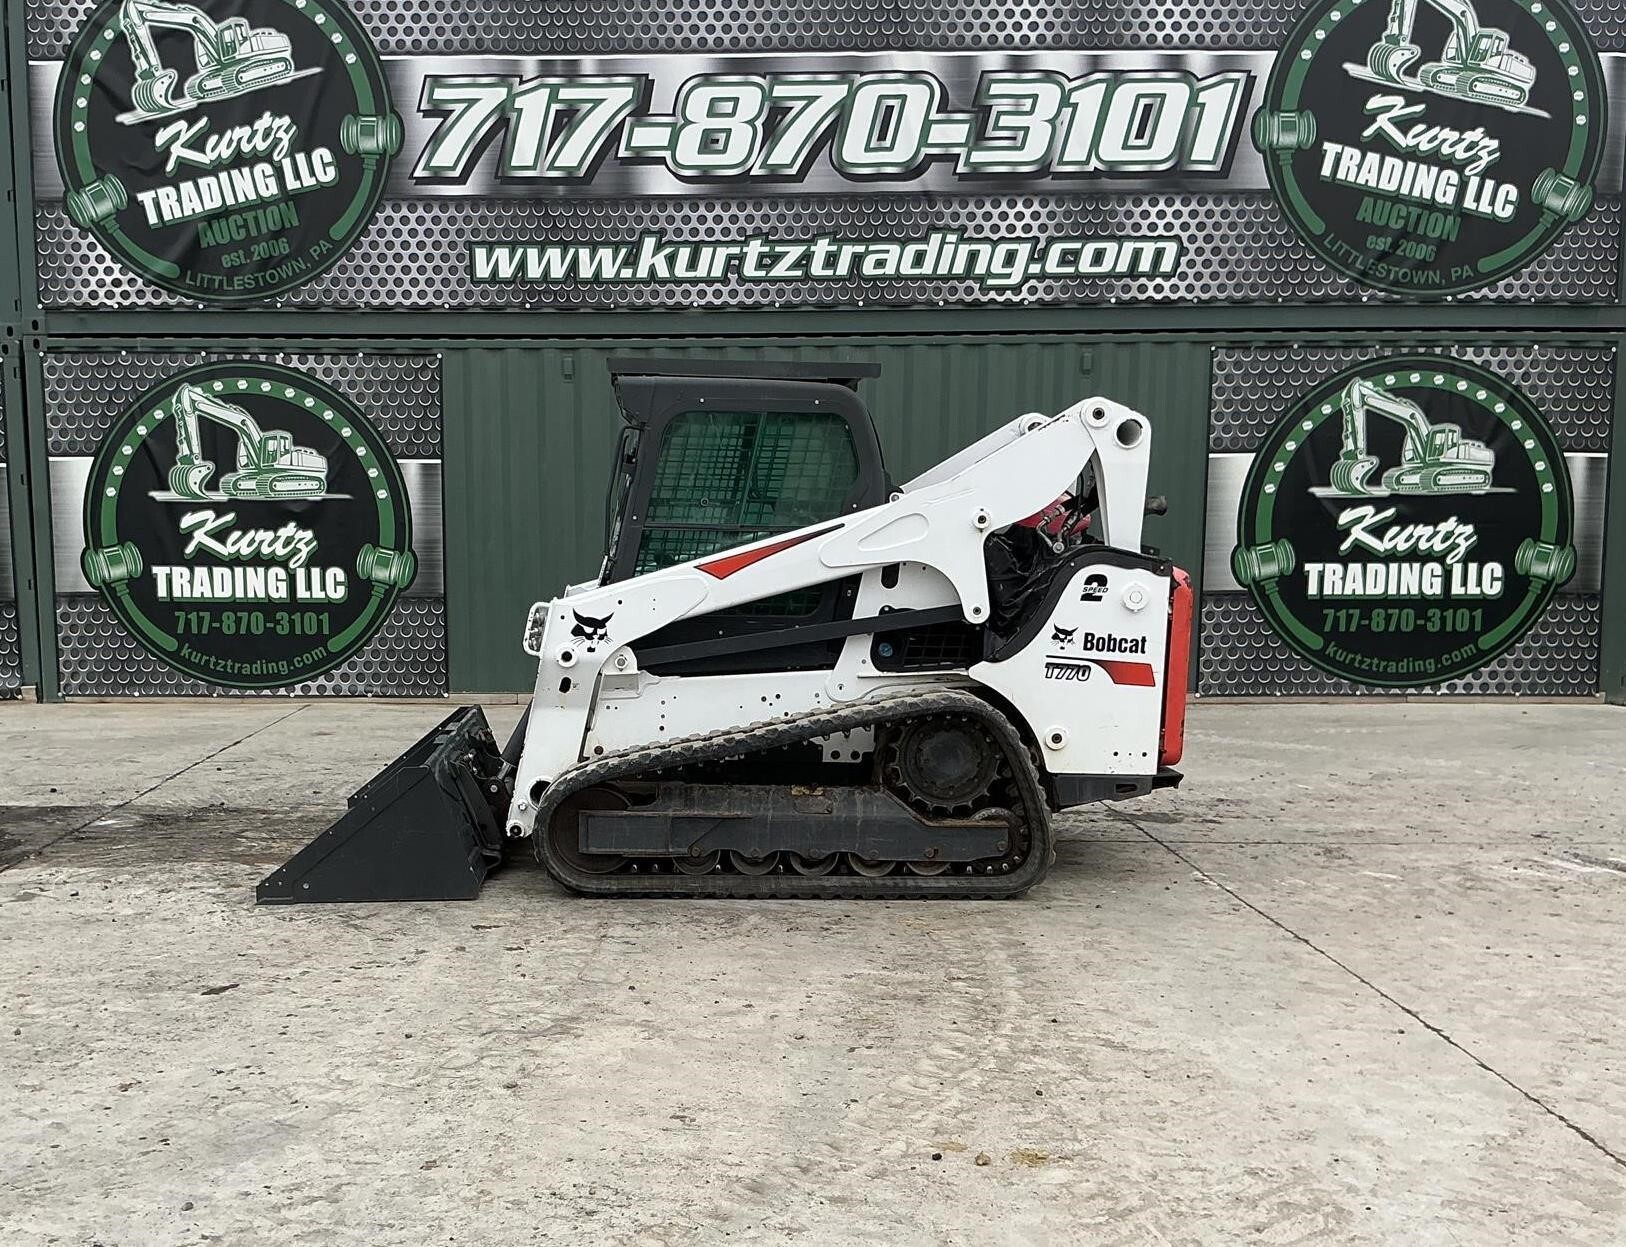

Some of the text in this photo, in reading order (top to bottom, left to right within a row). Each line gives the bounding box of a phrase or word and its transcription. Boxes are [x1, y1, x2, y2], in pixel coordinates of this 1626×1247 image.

[155, 111, 297, 172] Kurtz
[414, 73, 1254, 182] 717-870-3101
[1360, 94, 1501, 174] Kurtz
[137, 147, 338, 227] TRADING LLC
[1320, 142, 1520, 221] TRADING LLC
[198, 201, 300, 248] AUCTION
[1356, 197, 1461, 242] AUCTION
[185, 238, 334, 291] LITTLESTOWN, PA
[221, 237, 290, 269] est. 2006
[472, 230, 1182, 288] www.kurtztrading.com
[1323, 233, 1475, 286] LITTLESTOWN, PA
[1396, 238, 1437, 263] 2006
[179, 510, 318, 568] Kurtz
[1337, 505, 1477, 564] Kurtz
[152, 566, 349, 603] TRADING LLC
[1080, 573, 1108, 602] 2
[1082, 586, 1109, 594] SPEED
[1304, 562, 1504, 600] TRADING LLC
[174, 611, 331, 636] 717-870-3101
[1322, 607, 1484, 634] 717-870-3101
[181, 643, 328, 676] kurtztrading.com
[1083, 632, 1147, 654] Bobcat
[1325, 641, 1477, 674] kurtztrading.com
[1045, 662, 1091, 682] T770
